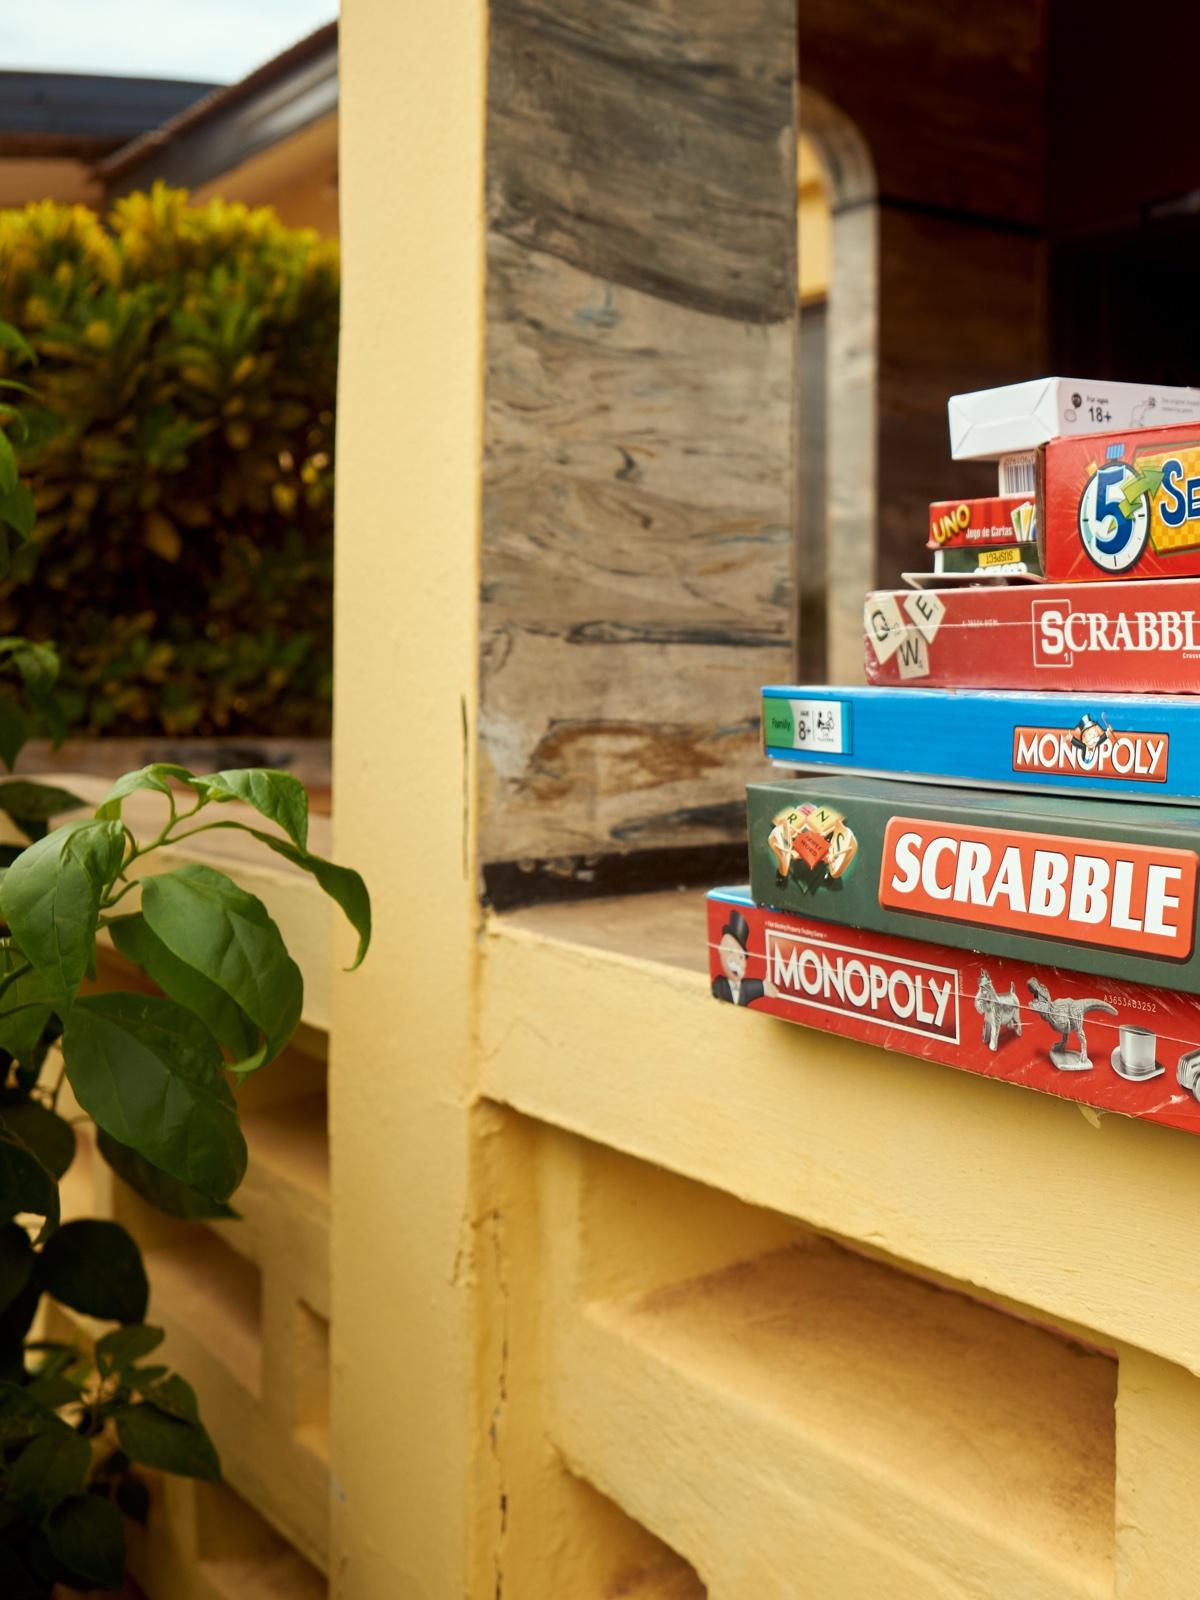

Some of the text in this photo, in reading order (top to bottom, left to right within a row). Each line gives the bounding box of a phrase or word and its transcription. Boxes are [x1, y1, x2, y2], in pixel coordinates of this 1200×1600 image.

[1088, 406, 1112, 424] 18+
[932, 503, 970, 543] UNO
[1092, 465, 1134, 556] 5
[981, 526, 990, 537] de
[986, 550, 1014, 564] SUSPECT
[915, 595, 934, 622] E
[871, 610, 891, 642] Q
[899, 638, 920, 666] W
[798, 720, 811, 741] 8+
[787, 813, 797, 824] R
[891, 832, 1182, 937] SCRABBLE
[774, 943, 952, 1028] MONOPOLY
